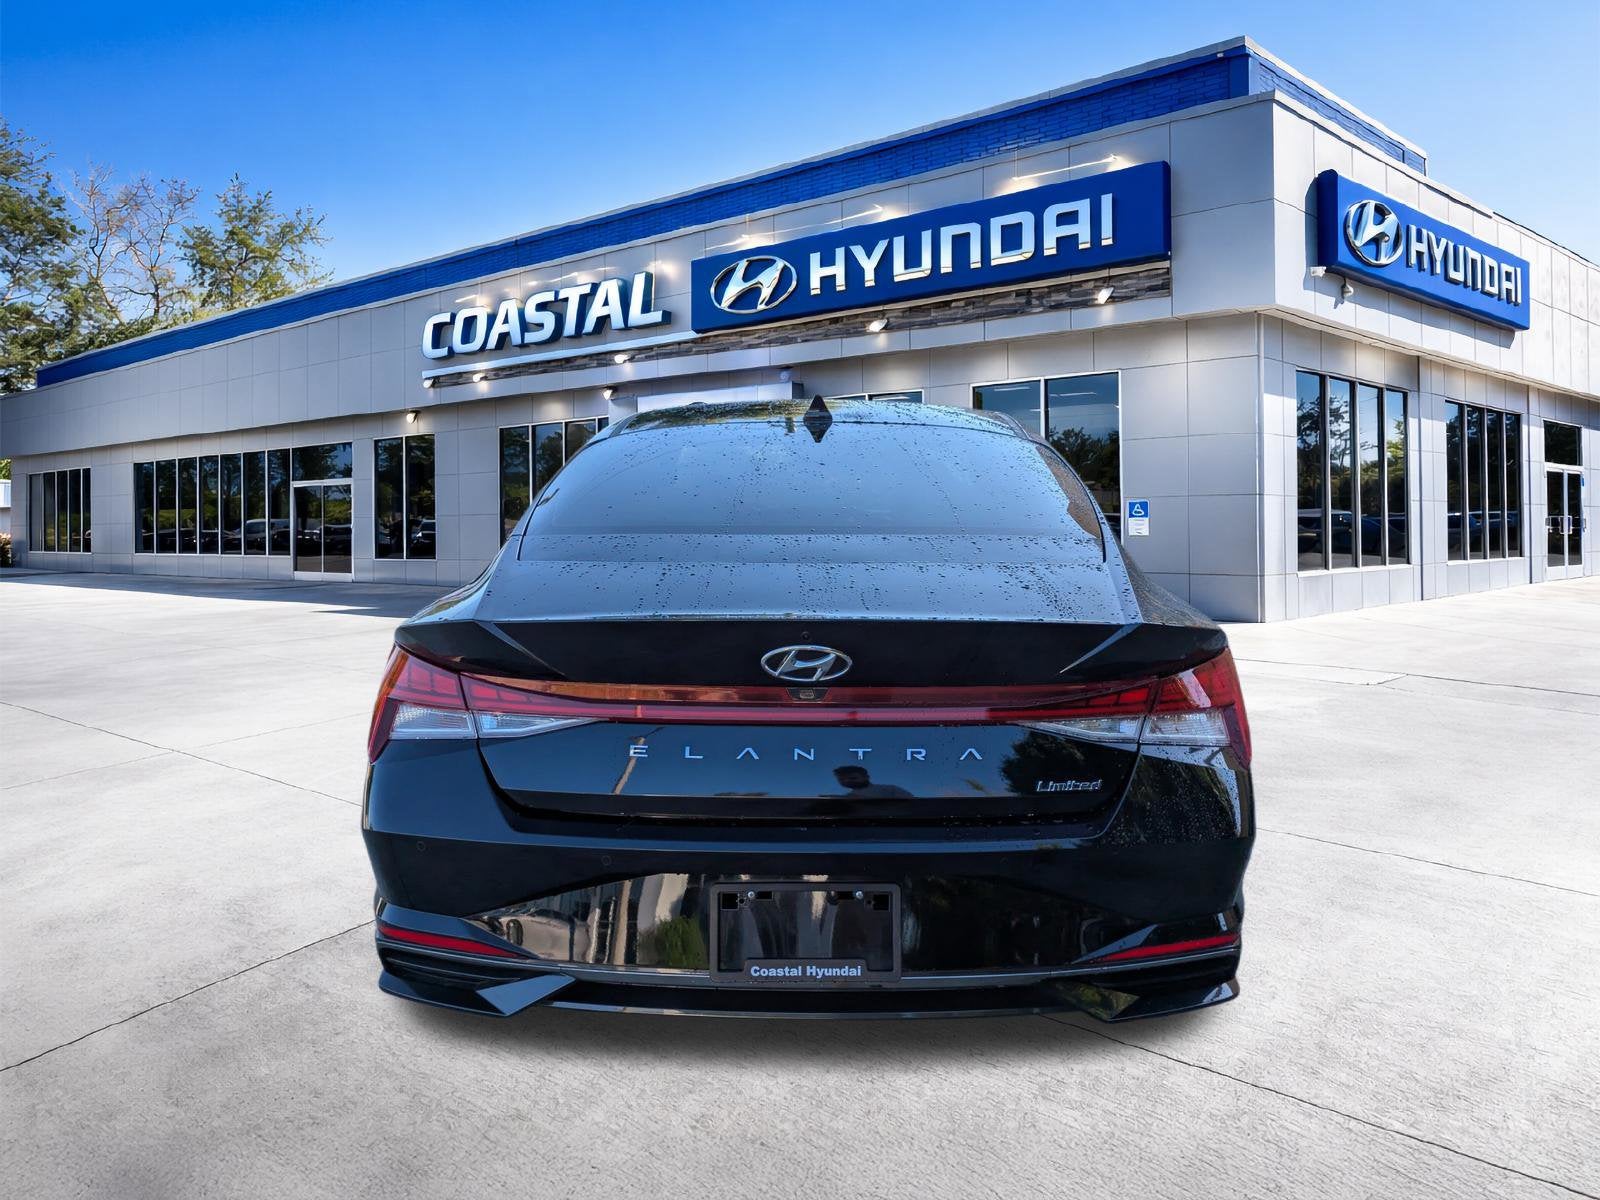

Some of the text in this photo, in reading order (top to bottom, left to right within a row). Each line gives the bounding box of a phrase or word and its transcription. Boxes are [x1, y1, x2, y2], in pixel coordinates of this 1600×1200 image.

[809, 193, 1113, 295] HYUNDAI
[1408, 225, 1522, 305] HYUNDAI
[422, 271, 669, 359] COASTAL
[629, 745, 982, 761] ELANTRA
[1037, 780, 1102, 792] Limited
[750, 965, 861, 979] Coastal Hyundai
